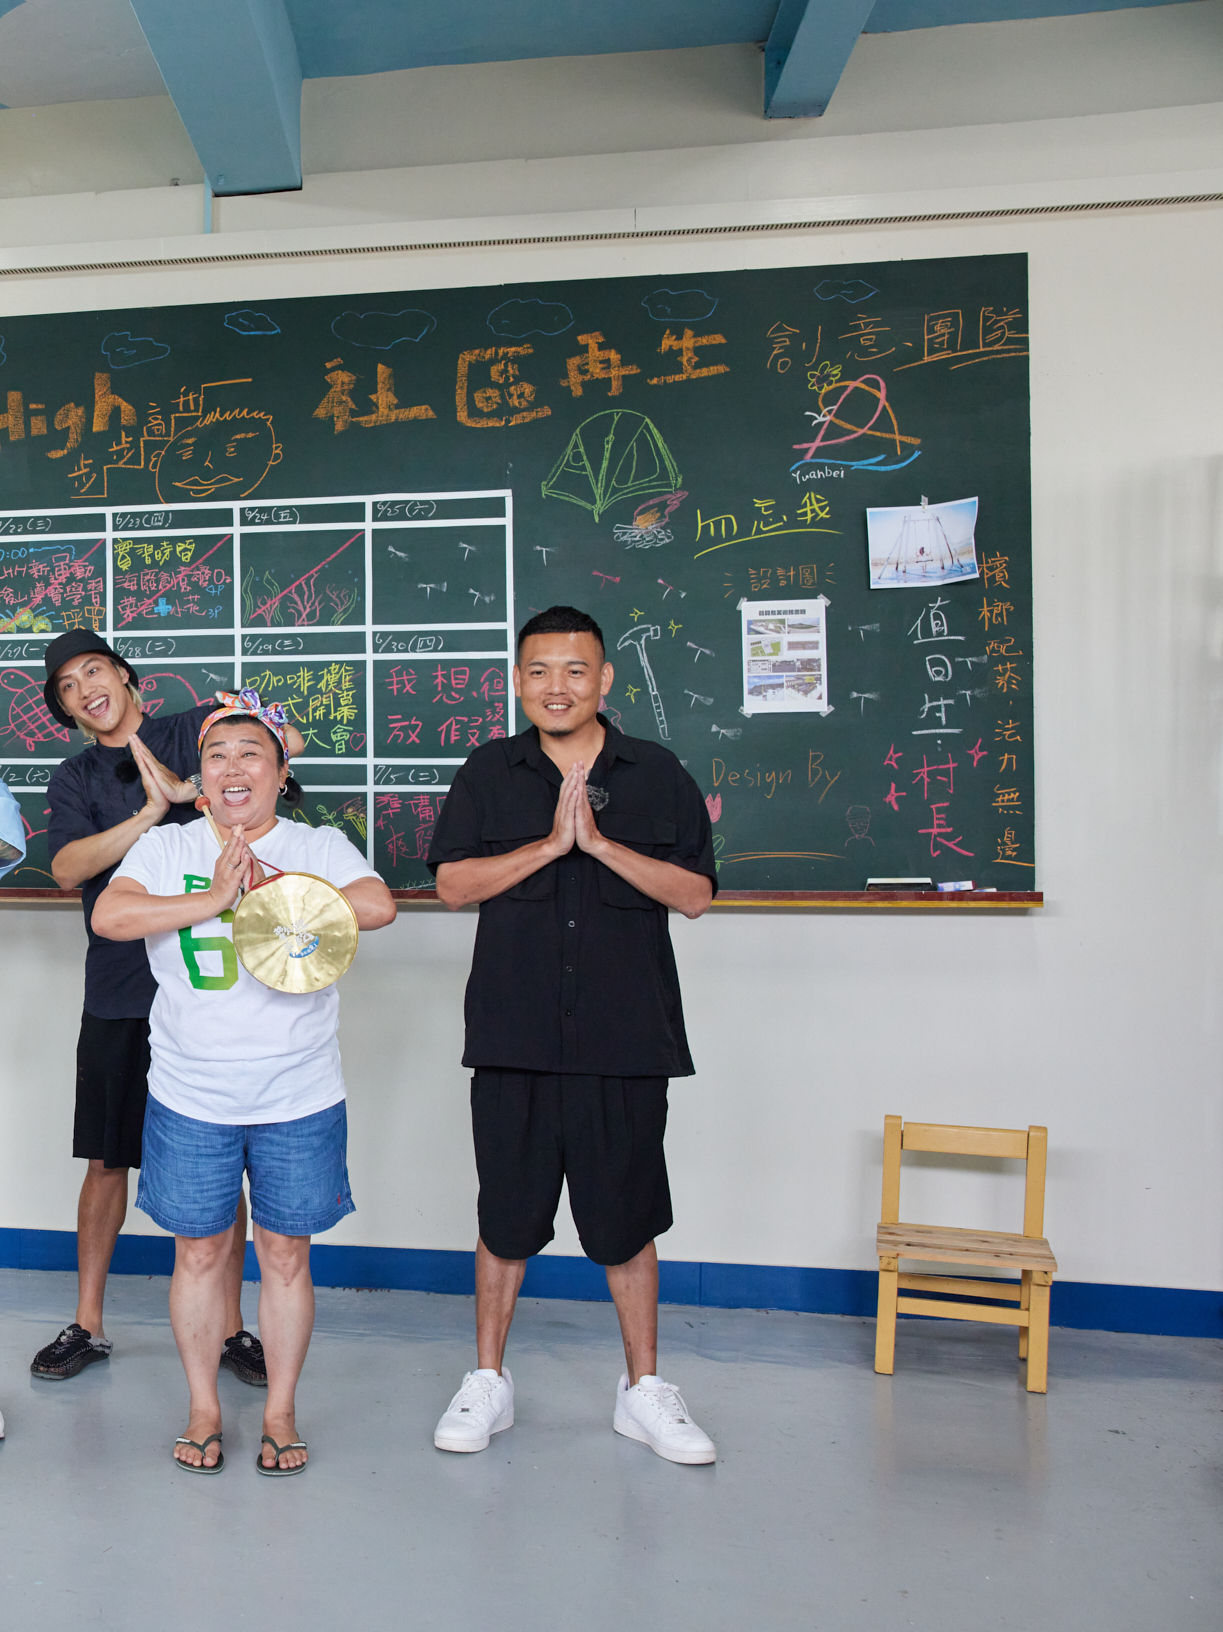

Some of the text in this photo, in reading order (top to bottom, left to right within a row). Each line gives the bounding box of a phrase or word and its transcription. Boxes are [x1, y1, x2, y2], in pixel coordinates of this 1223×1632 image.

[312, 328, 731, 434] 社區再生
[791, 465, 846, 485] Yuanbei
[696, 492, 833, 542] 勿忘我
[748, 564, 818, 592] 設計圖
[712, 749, 841, 804] Design By
